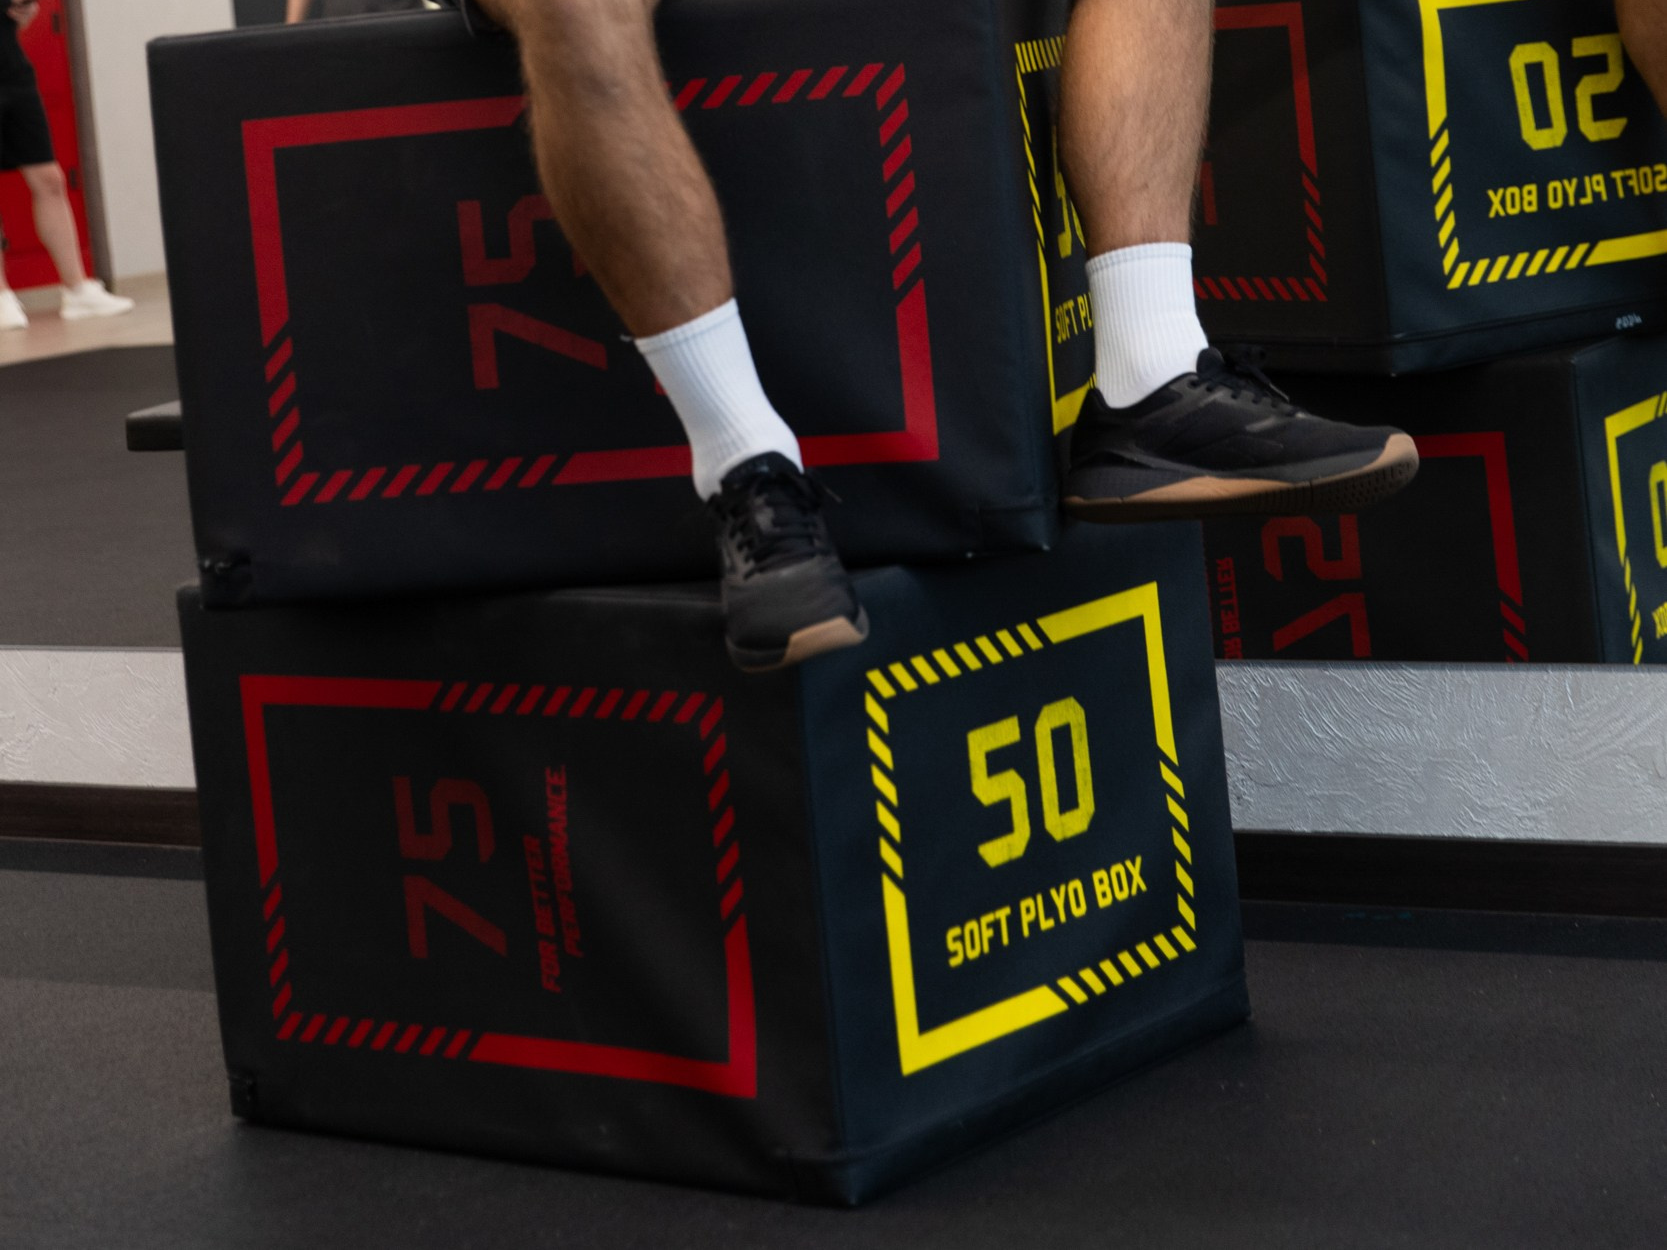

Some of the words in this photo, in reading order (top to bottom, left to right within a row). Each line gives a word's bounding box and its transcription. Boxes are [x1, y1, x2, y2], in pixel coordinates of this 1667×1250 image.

[1076, 292, 1093, 332] PL
[967, 696, 1096, 868] 50
[393, 775, 507, 959] 75
[523, 834, 556, 936] BETTER
[946, 905, 1012, 968] SOFT
[1019, 878, 1087, 938] PLYO
[1092, 855, 1147, 909] BOX
[539, 940, 562, 993] FOR
